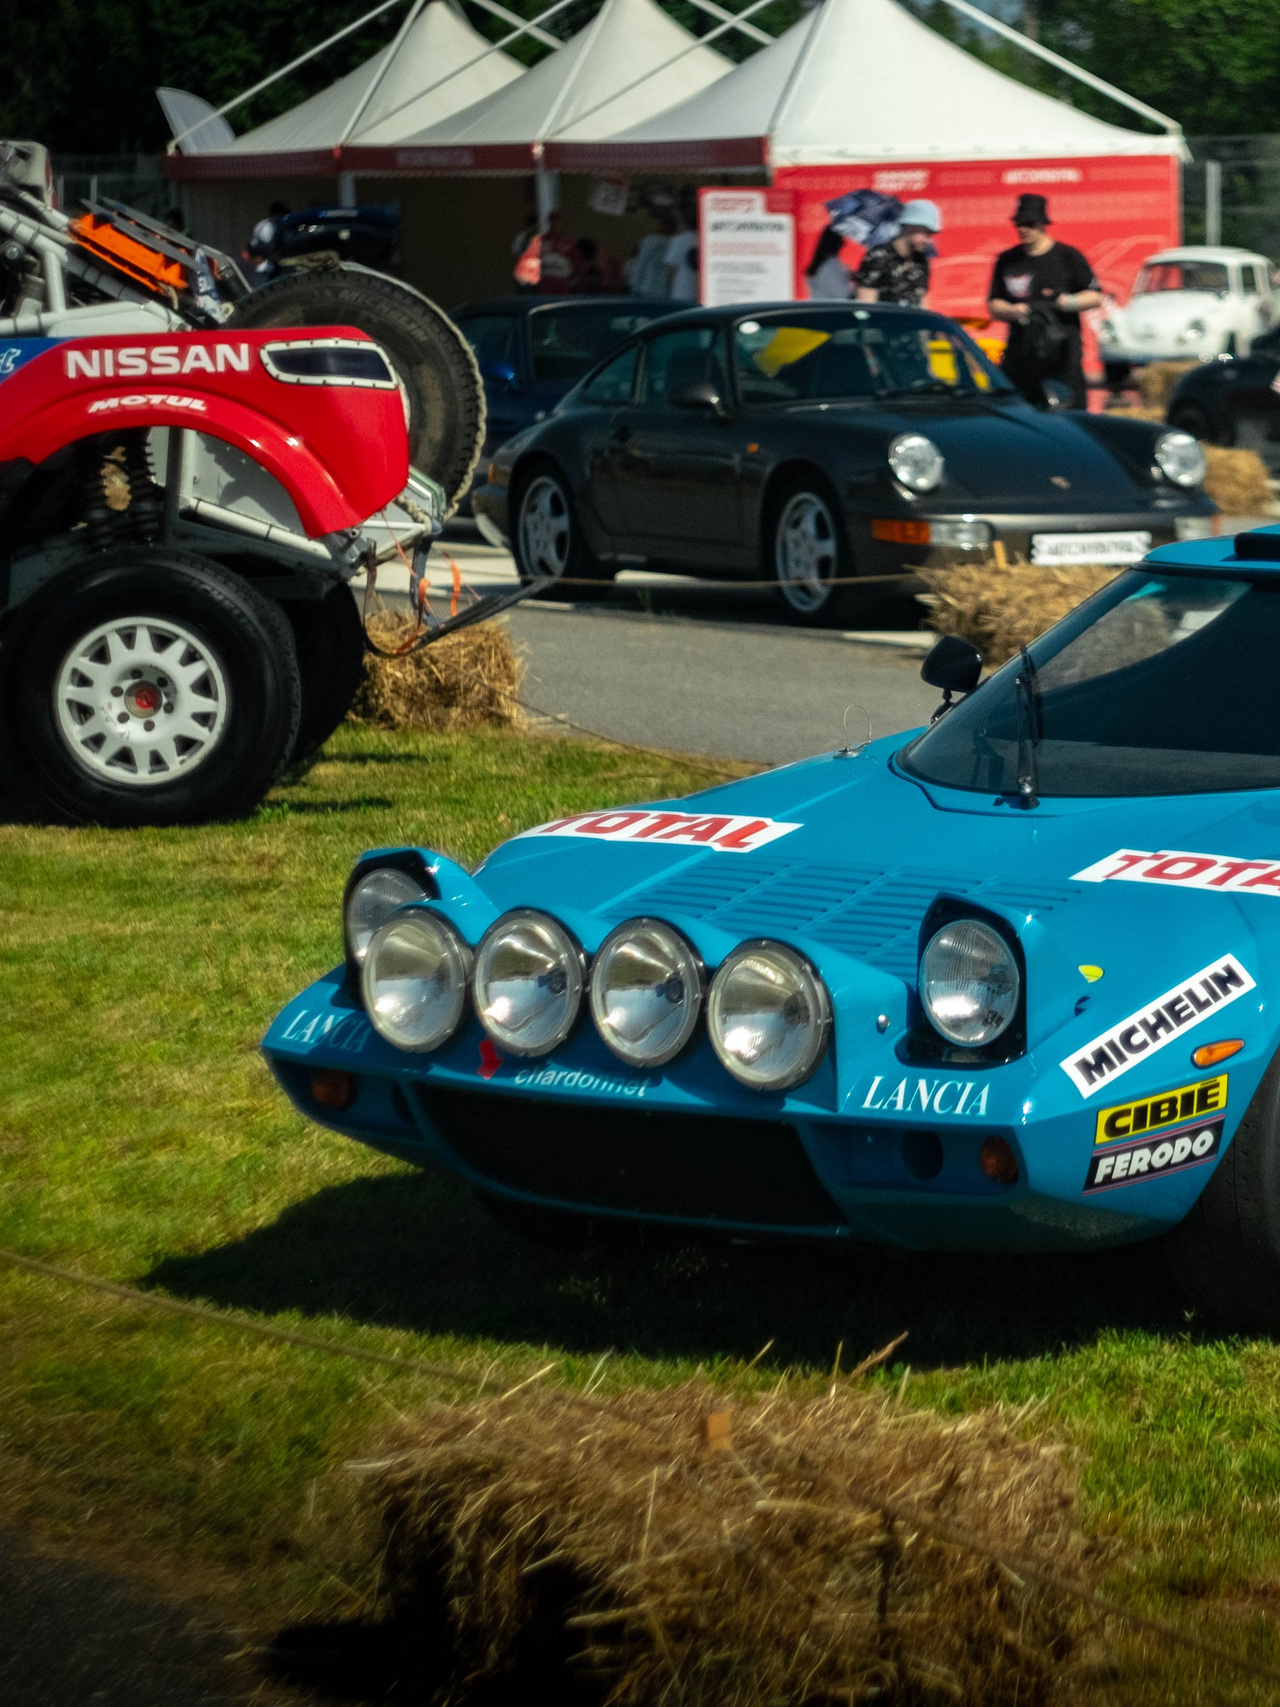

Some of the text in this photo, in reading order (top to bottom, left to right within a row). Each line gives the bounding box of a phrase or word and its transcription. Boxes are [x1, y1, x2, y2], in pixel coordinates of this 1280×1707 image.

[67, 343, 249, 378] NISSAN
[88, 394, 207, 413] MOTUL
[538, 812, 771, 849] TOTAL
[280, 1010, 373, 1053] LANCIA
[1074, 963, 1245, 1086] MICHELIN
[513, 1066, 651, 1098] chardonnet
[860, 1075, 990, 1117] LANCIA
[1093, 1130, 1215, 1185] FERODO
